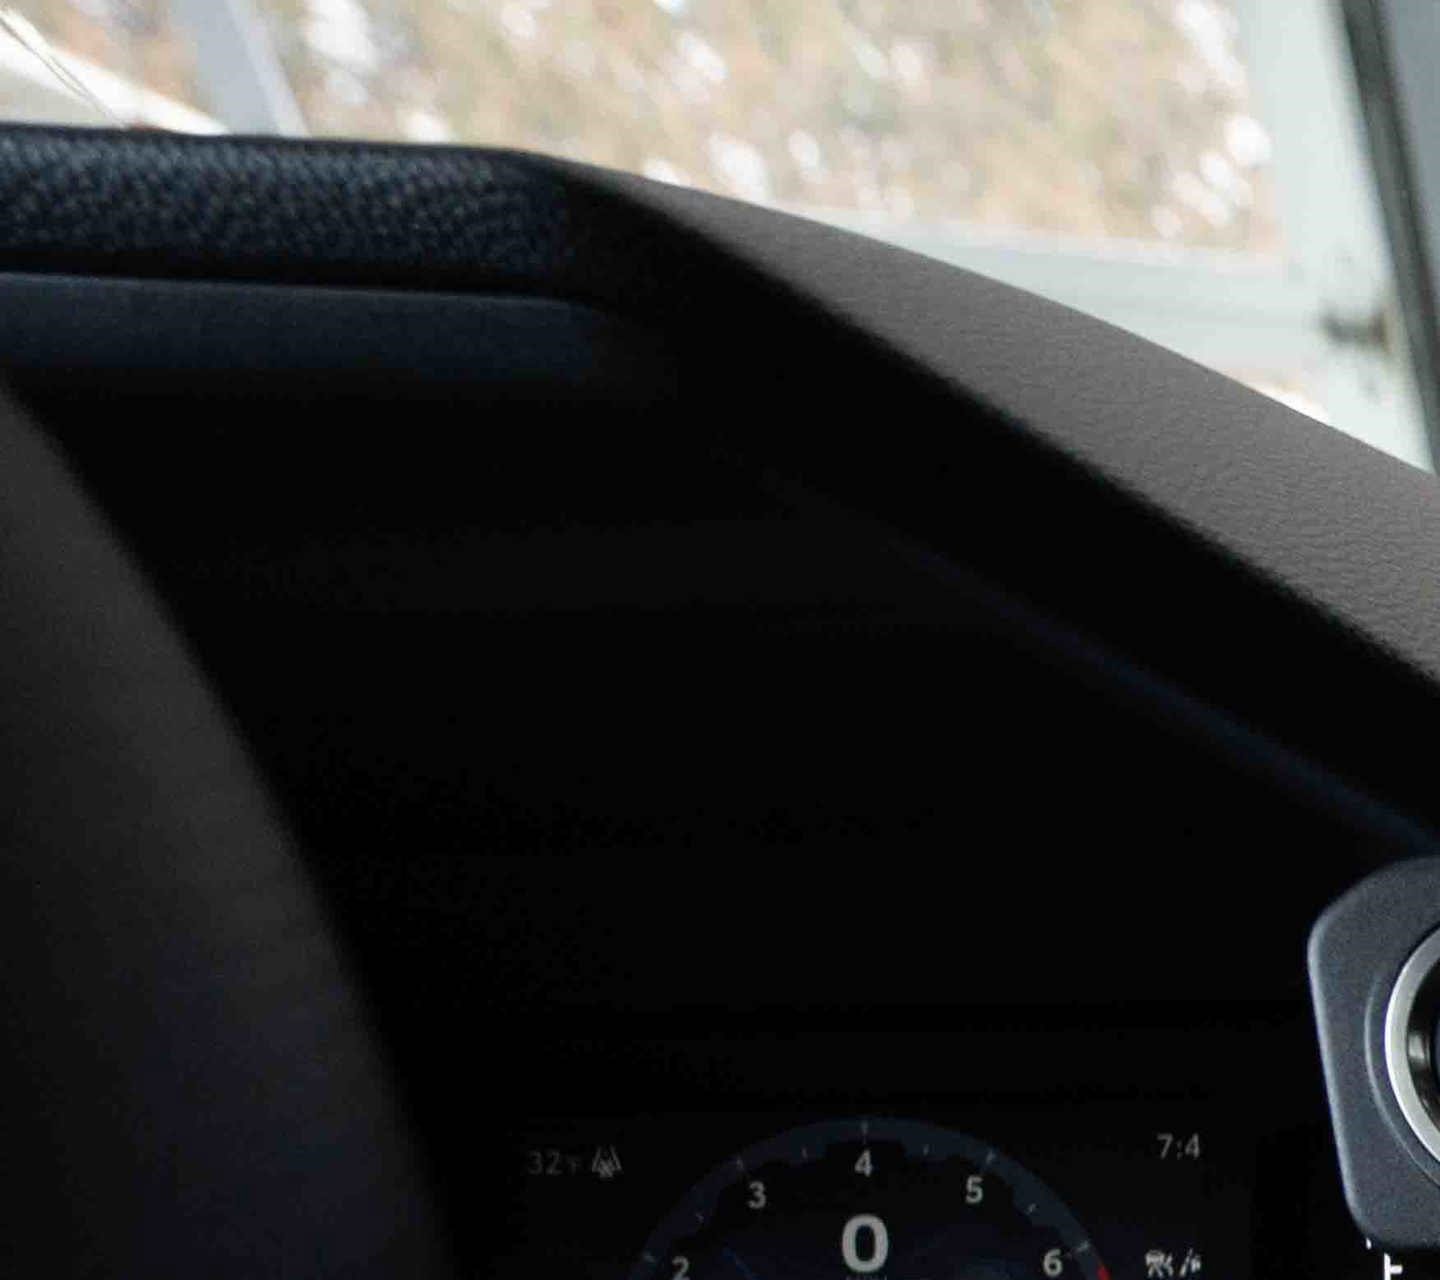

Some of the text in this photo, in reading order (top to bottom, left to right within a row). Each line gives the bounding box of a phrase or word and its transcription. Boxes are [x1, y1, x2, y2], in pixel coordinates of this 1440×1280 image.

[854, 1150, 873, 1178] 4
[747, 1180, 769, 1210] 3
[965, 1175, 985, 1204] 5
[840, 1213, 891, 1274] 0
[1041, 1249, 1064, 1278] 6
